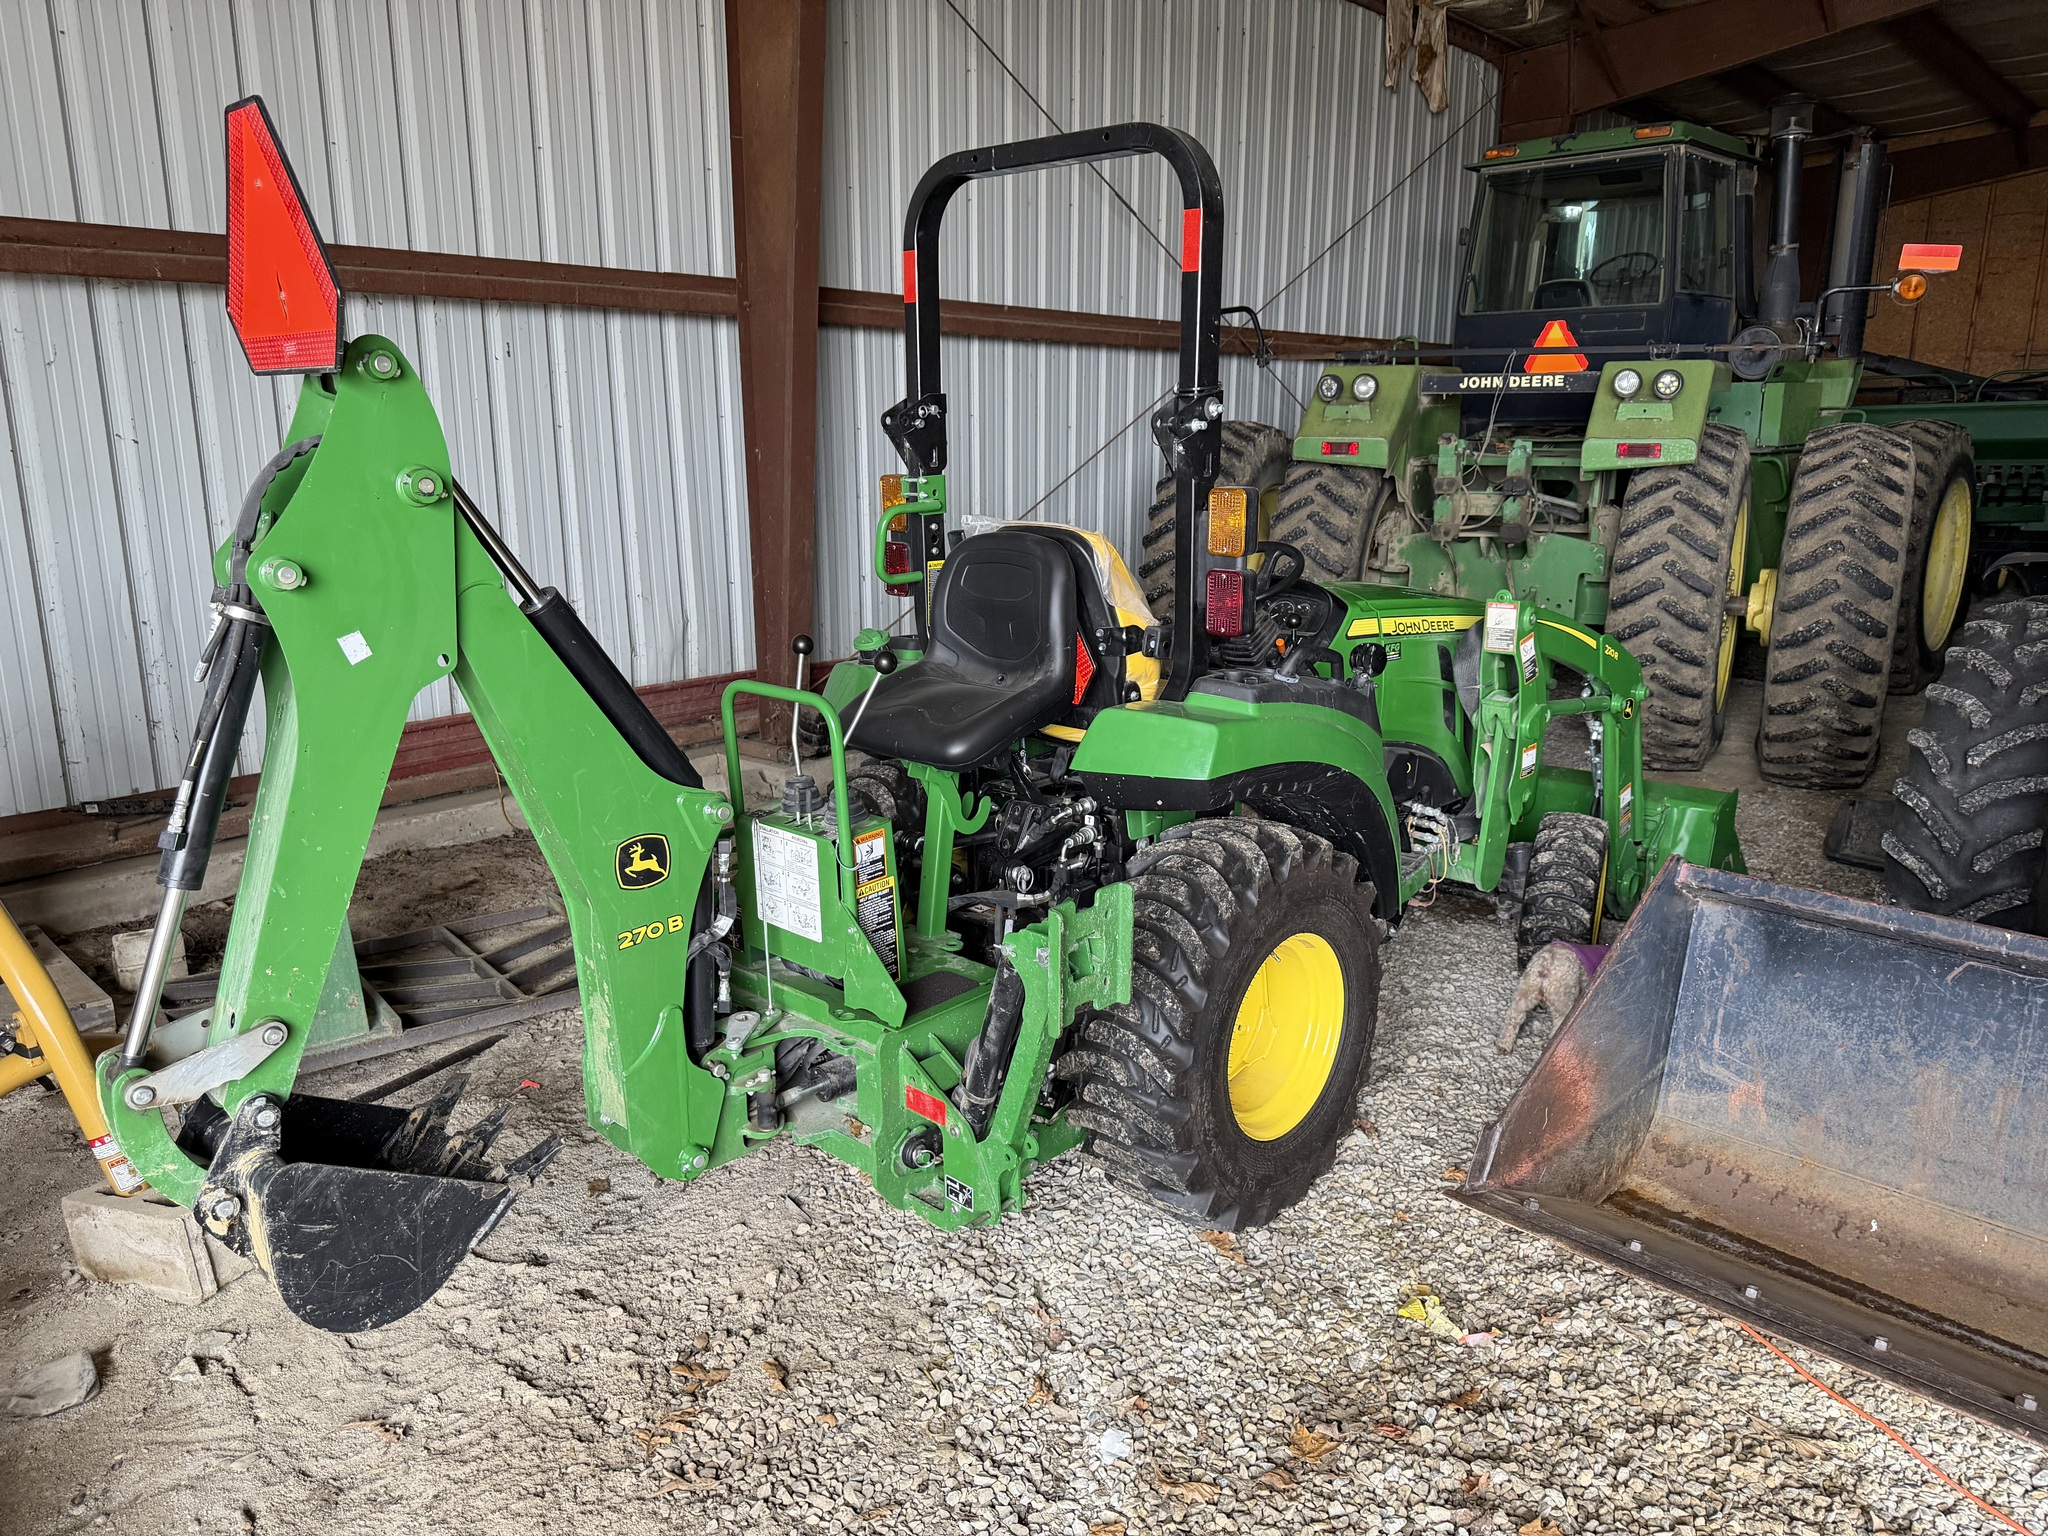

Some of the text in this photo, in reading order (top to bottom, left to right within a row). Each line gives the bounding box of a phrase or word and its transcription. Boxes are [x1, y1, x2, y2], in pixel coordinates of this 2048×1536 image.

[1459, 375, 1565, 389] JOHN DEERE
[1392, 619, 1455, 633] JOHN DEERE
[1385, 643, 1401, 652] KFG
[860, 830, 884, 842] WARNING
[864, 878, 890, 894] CAUTION
